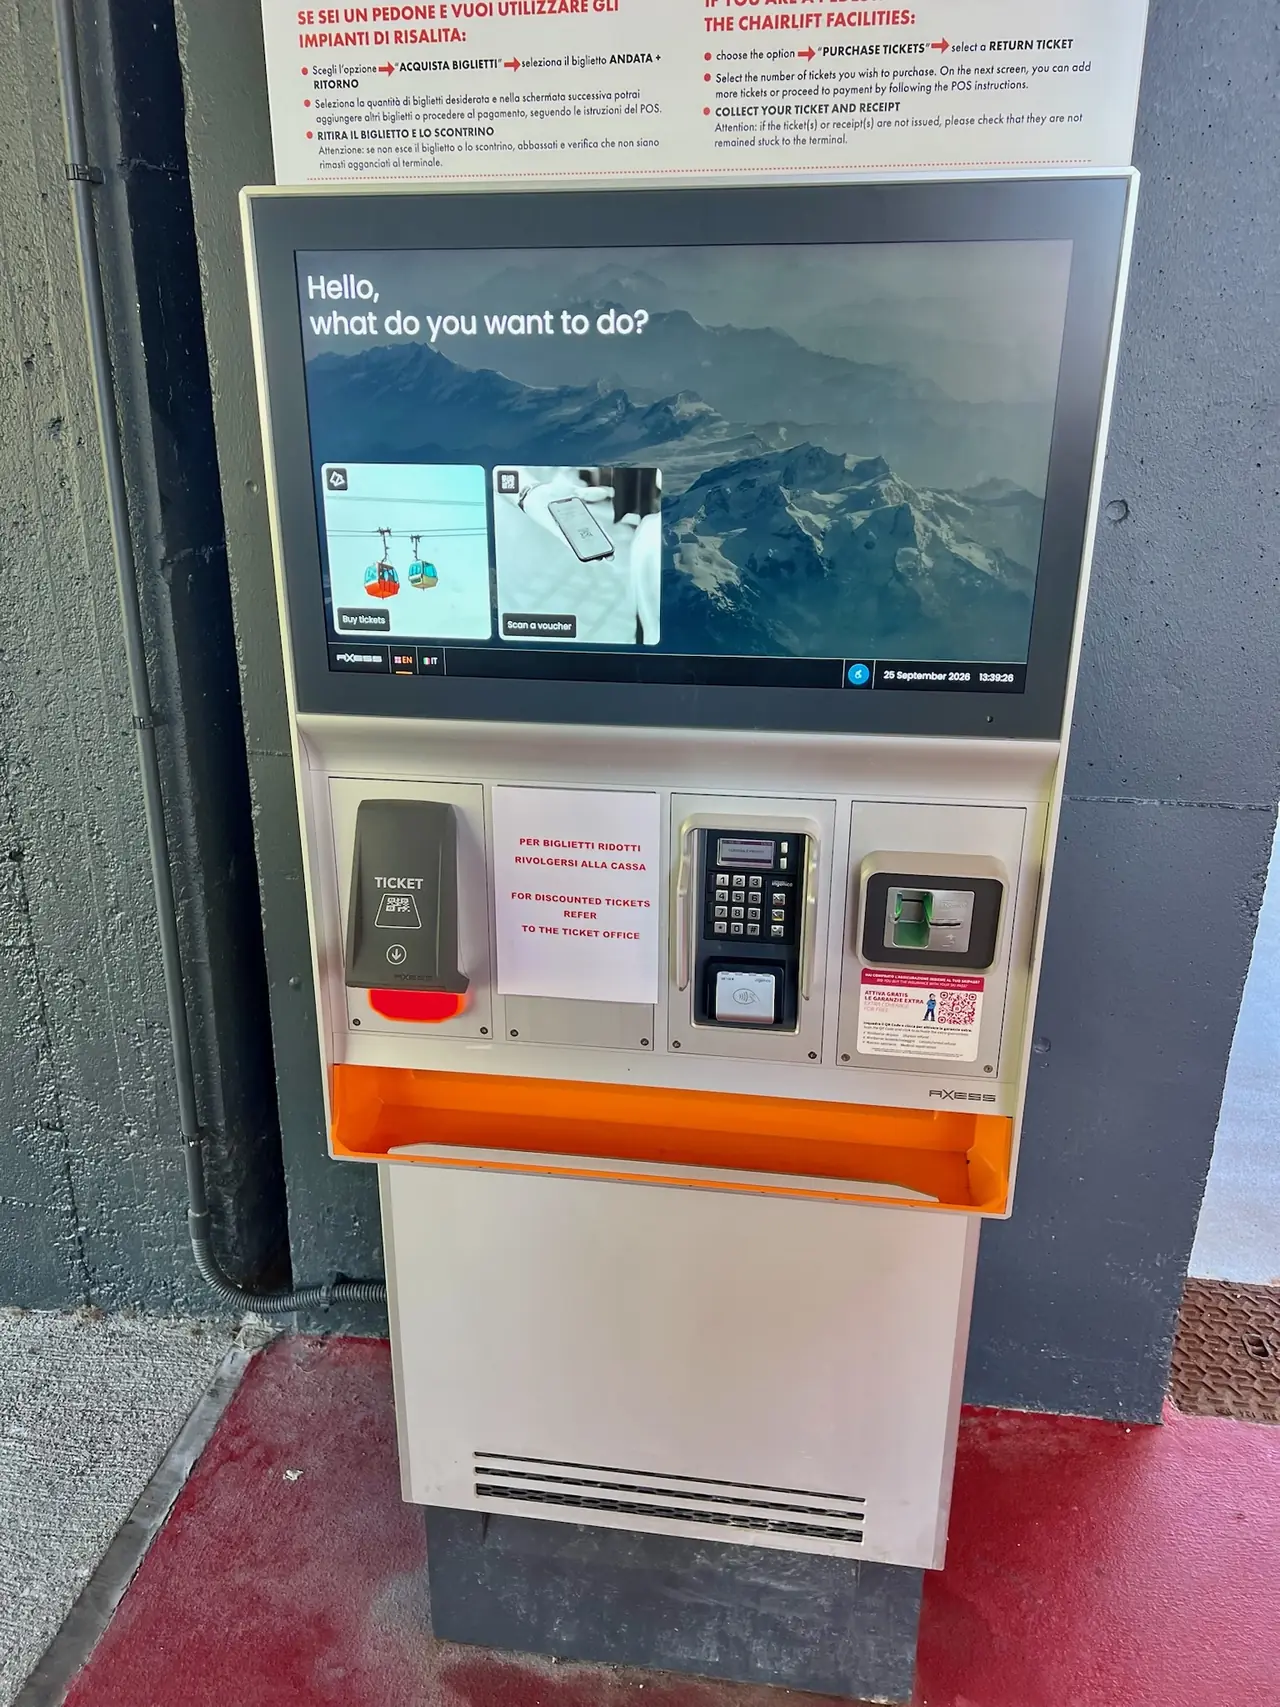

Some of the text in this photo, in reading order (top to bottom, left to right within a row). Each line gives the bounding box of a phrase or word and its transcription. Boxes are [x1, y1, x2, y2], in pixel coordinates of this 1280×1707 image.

[298, 0, 618, 25] SE SEI UN PEDONE E VUOI UTILIZZARE GLI
[704, 10, 915, 32] THE CHAIRLIFT FACILITIES:
[300, 28, 466, 48] IMPIANTI DI RISALITA:
[716, 50, 748, 60] choose
[750, 49, 764, 59] the
[766, 48, 795, 61] option
[952, 42, 978, 52] select
[989, 40, 1034, 51] RETURN
[1036, 39, 1074, 50] TICKET
[312, 64, 337, 77] Scegli
[339, 64, 377, 76] l'opzione
[522, 57, 562, 68] seleziona
[564, 55, 569, 66] il
[572, 55, 606, 68] biglietto
[609, 53, 653, 64] ANDATA
[716, 61, 1091, 83] Select the number of tickets you wish to purchase. On the next screen, you can add
[314, 79, 359, 89] RITORNO
[740, 87, 767, 98] tickets
[782, 85, 819, 98] proceed
[822, 86, 830, 95] to
[833, 85, 872, 97] payment
[875, 83, 887, 96] by
[889, 82, 932, 94] following
[934, 81, 948, 91] the
[951, 80, 972, 91] POS
[974, 80, 1028, 90] instructions.
[315, 98, 355, 109] Seleziona
[357, 97, 365, 107] la
[367, 96, 400, 110] quantità
[402, 96, 410, 106] di
[412, 95, 443, 108] biglietti
[446, 94, 490, 105] desiderata
[500, 92, 520, 103] nella
[522, 92, 566, 102] schermata
[568, 90, 612, 101] successiva
[614, 89, 640, 102] potrai
[316, 113, 362, 126] aggiungere
[364, 112, 380, 122] altri
[382, 111, 412, 124] biglietti
[422, 109, 465, 122] procedere
[467, 108, 475, 119] al
[477, 109, 528, 121] pagamento,
[530, 106, 572, 119] seguendo
[574, 105, 581, 116] le
[584, 105, 622, 115] istruzioni
[624, 103, 638, 114] del
[640, 103, 662, 113] POS.
[715, 102, 900, 117] COLLECT YOUR TICKET AND RECEIPT
[714, 122, 757, 132] Attention:
[760, 120, 766, 131] if
[768, 120, 781, 131] the
[784, 119, 818, 132] ticket(s)
[832, 117, 874, 131] receipt(s)
[876, 120, 892, 128] are
[894, 118, 909, 127] not
[912, 115, 942, 127] issued,
[945, 115, 975, 128] please
[978, 114, 1004, 124] check
[1006, 114, 1024, 124] that
[1026, 113, 1047, 126] they
[1067, 113, 1083, 122] not
[318, 127, 494, 140] RITIRA IL BIGLIETTO E LO SCONTRINO
[714, 133, 847, 148] remained stuck to the terminal.
[308, 274, 379, 303] Hello,
[310, 308, 649, 343] what do you want to do?
[342, 615, 386, 625] Buy tickets
[507, 620, 528, 629] Scan
[537, 622, 572, 630] voucher
[402, 656, 412, 664] EN
[884, 670, 895, 679] 25
[896, 671, 947, 681] September
[520, 838, 640, 852] PER BIGLIETTI RIDOTTI
[515, 856, 646, 870] RIVOLGERSI ALLA CASSA
[374, 877, 424, 889] TICKET
[512, 892, 650, 907] FOR DISCOUNTED TICKETS
[564, 910, 596, 919] REFER
[539, 926, 558, 934] THE
[562, 928, 600, 937] TICKET
[603, 931, 639, 939] OFFICE
[929, 1089, 996, 1102] AXESS
